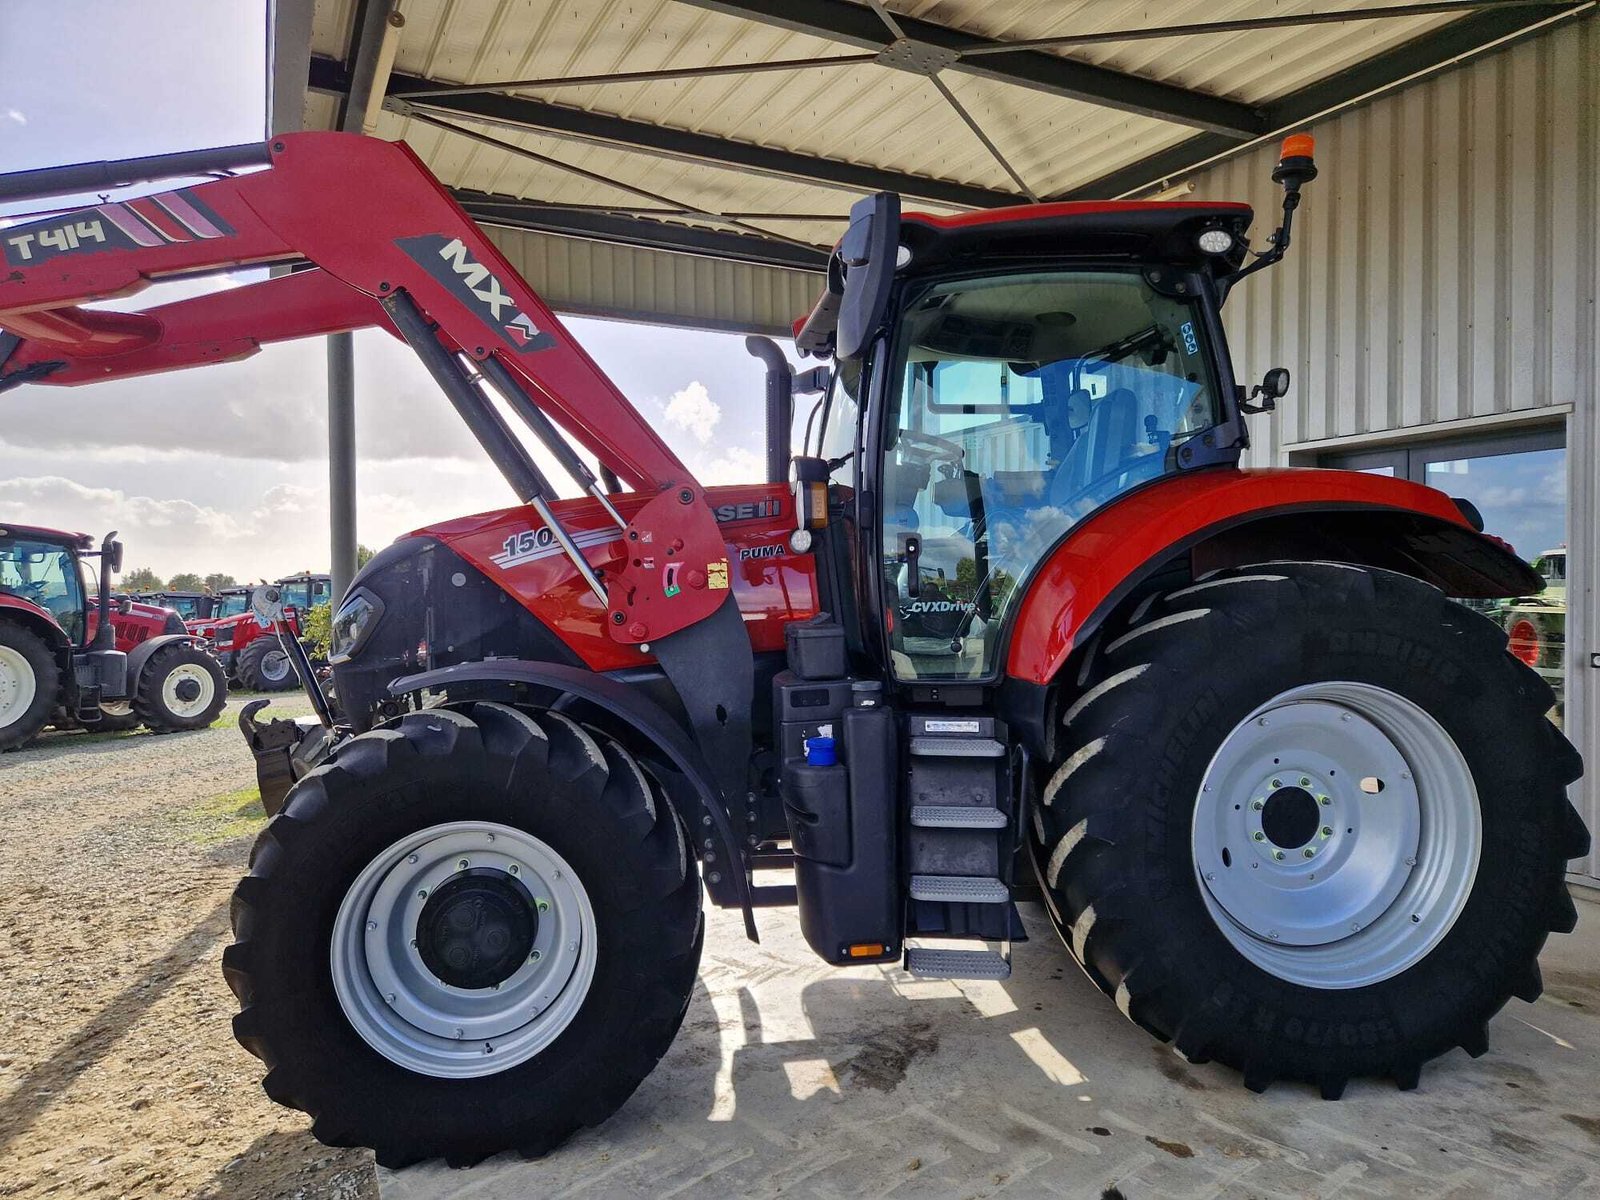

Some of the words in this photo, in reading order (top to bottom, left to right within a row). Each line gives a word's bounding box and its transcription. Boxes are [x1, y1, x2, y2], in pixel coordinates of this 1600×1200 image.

[8, 220, 106, 260] T414
[503, 526, 553, 558] 150
[740, 545, 786, 560] PUMA
[911, 601, 976, 613] CVXDrive
